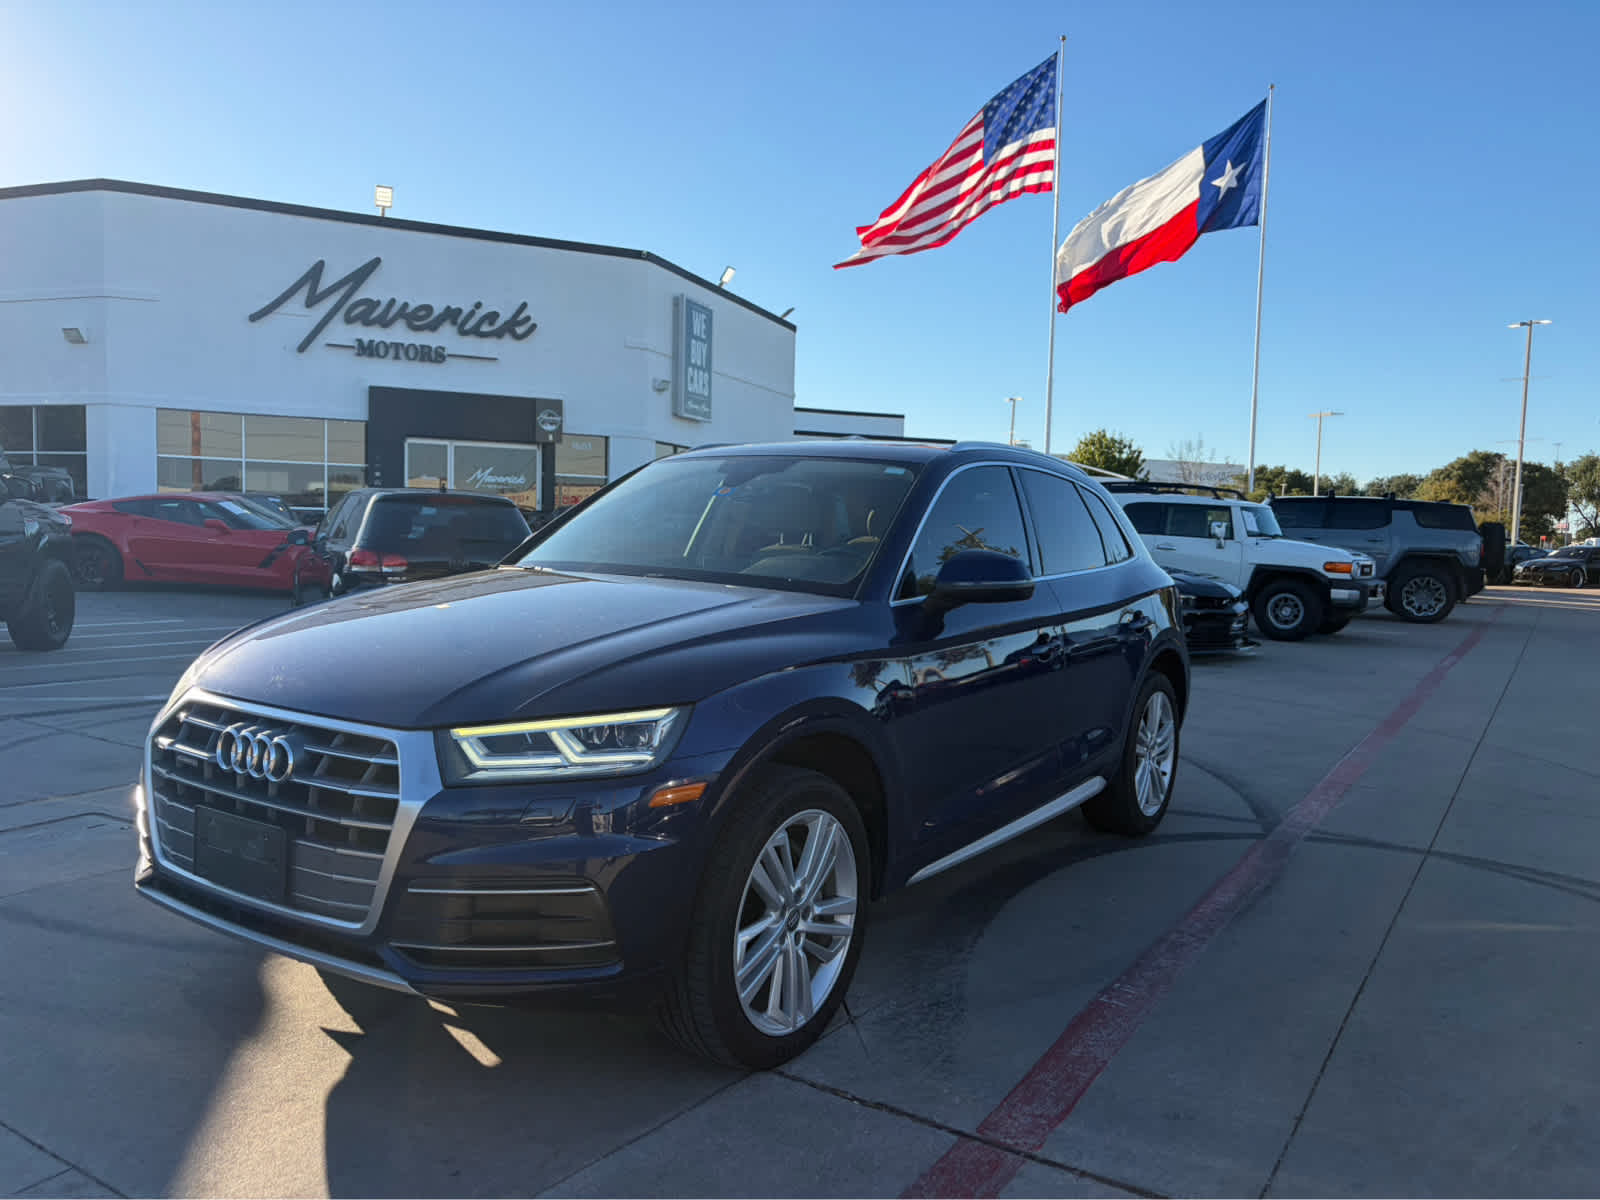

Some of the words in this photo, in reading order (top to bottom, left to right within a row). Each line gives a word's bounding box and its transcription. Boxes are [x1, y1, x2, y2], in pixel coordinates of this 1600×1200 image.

[249, 256, 538, 353] Maverick
[692, 310, 707, 338] WE
[354, 338, 447, 364] MOTORS
[690, 339, 708, 368] BUY
[687, 367, 709, 396] CARS
